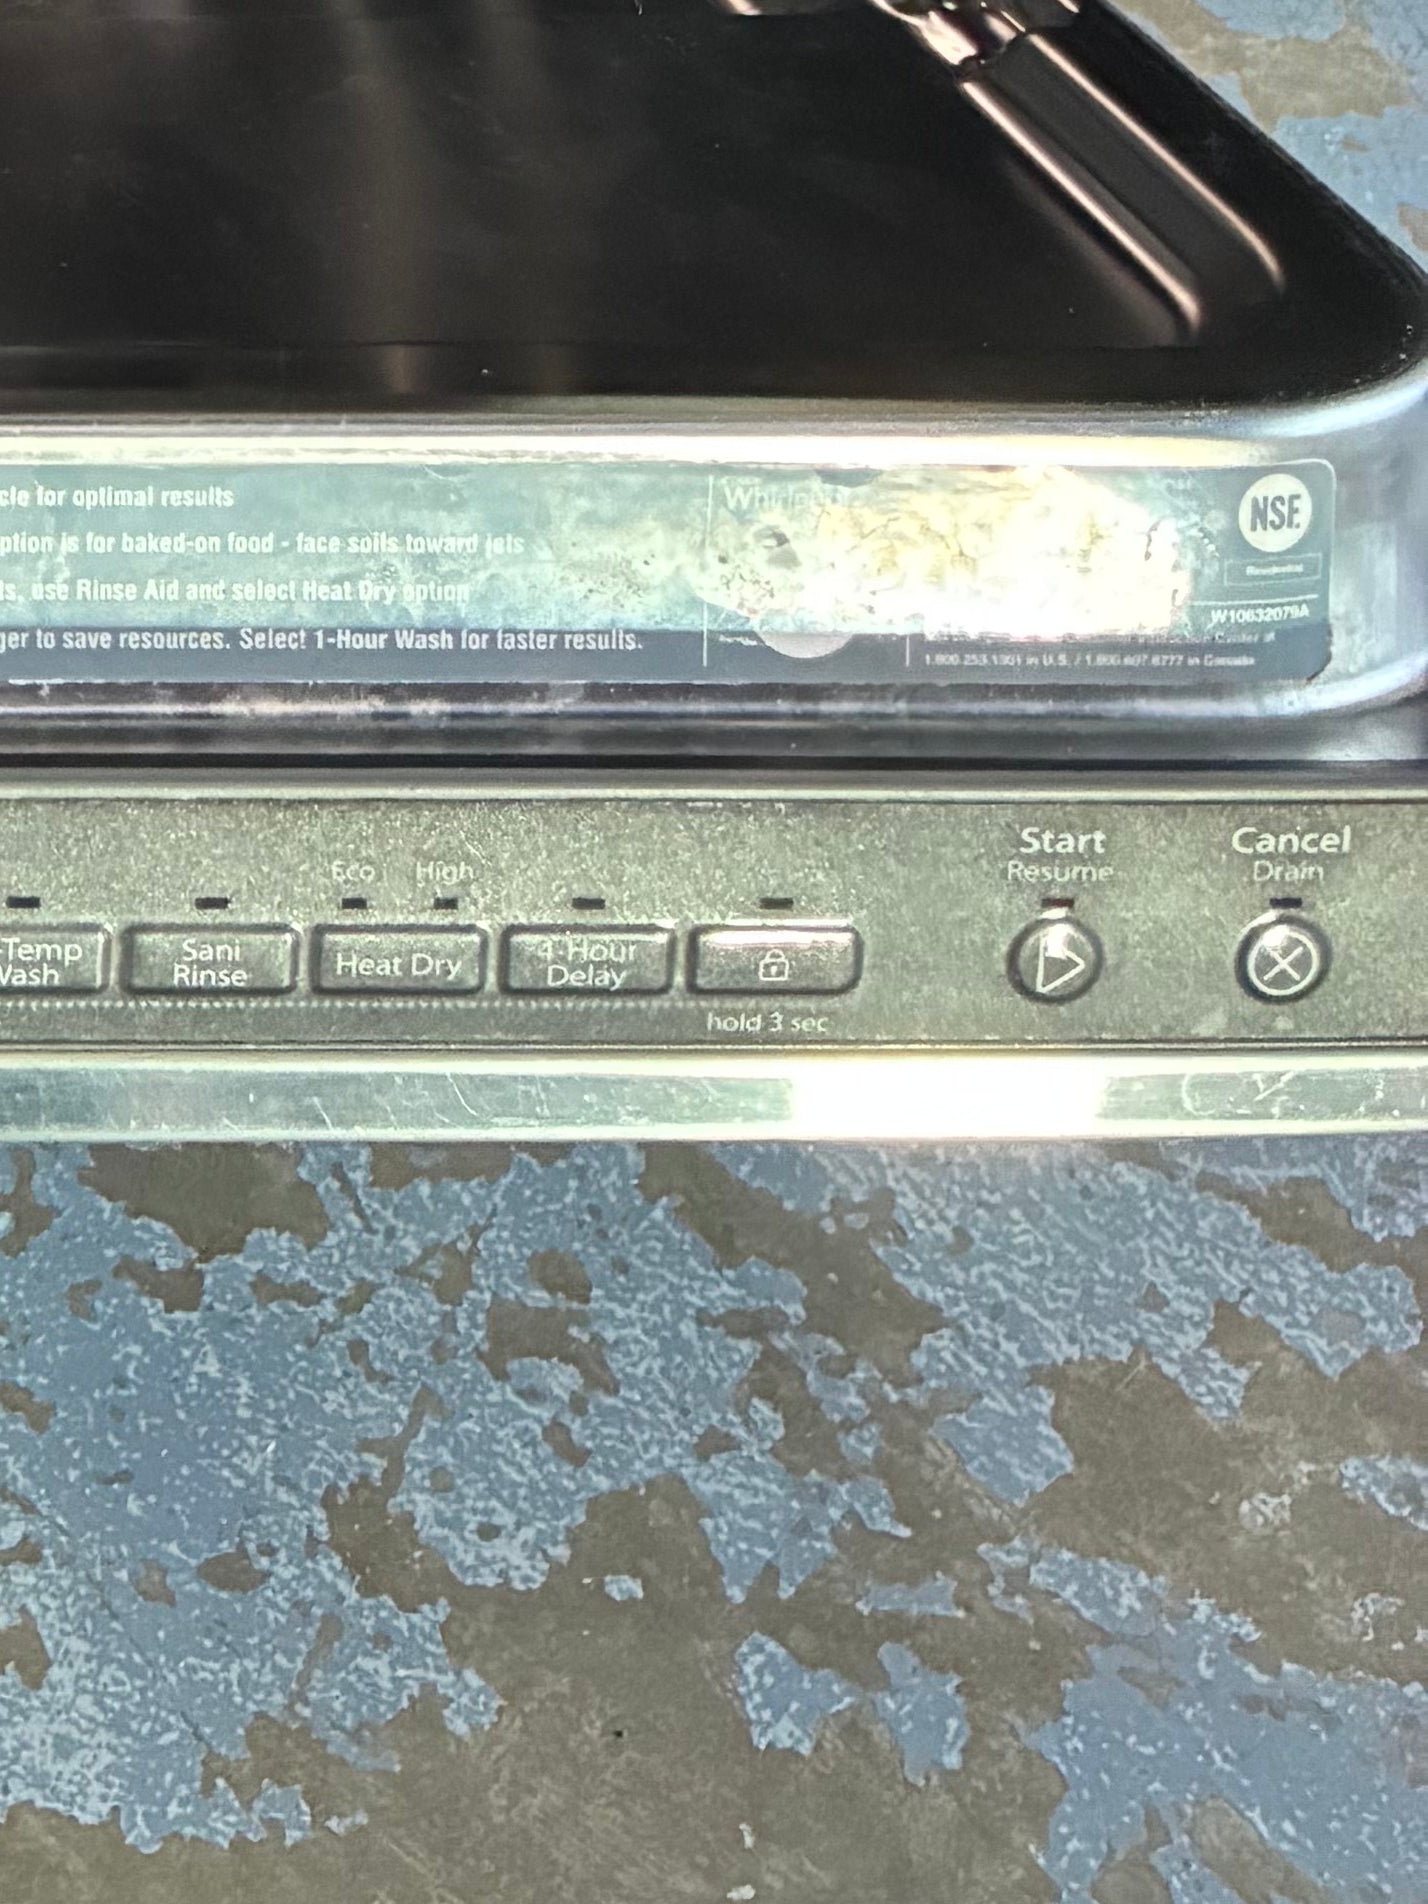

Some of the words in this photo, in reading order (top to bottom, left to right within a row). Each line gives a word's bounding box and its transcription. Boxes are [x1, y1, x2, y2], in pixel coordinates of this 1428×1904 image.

[36, 486, 64, 509] for
[72, 486, 153, 513] optimal
[161, 486, 234, 509] results
[60, 533, 79, 555] is
[86, 533, 116, 555] for
[121, 534, 221, 555] baked-on
[227, 534, 274, 555] food
[295, 534, 340, 555] face
[347, 534, 398, 555] soils
[405, 534, 478, 555] toward
[485, 534, 525, 559] jets
[30, 584, 68, 601] use
[75, 579, 136, 601] Rinse
[144, 580, 179, 602] Aid
[185, 580, 225, 602] and
[231, 580, 296, 602] select
[301, 580, 352, 602] Heat
[358, 580, 397, 606] Dry
[402, 580, 463, 606] option
[36, 628, 55, 650] to
[63, 633, 112, 650] save
[120, 633, 230, 650] resources.
[239, 629, 306, 651] Select
[314, 629, 388, 651] 1-Hour
[395, 629, 453, 651] Wash
[461, 629, 489, 651] for
[497, 629, 557, 651] faster
[564, 629, 642, 651] results.
[1019, 826, 1106, 854] Start
[1232, 824, 1351, 854] Cancel
[331, 860, 375, 881] Eco
[415, 861, 474, 886] High
[1007, 859, 1114, 883] Resume
[1252, 859, 1325, 882] Drain
[181, 938, 241, 962] Sani
[173, 964, 248, 987] Rinse
[335, 952, 402, 977] Heat
[411, 953, 463, 980] Dry
[546, 965, 627, 992] Delay
[706, 1011, 763, 1032] hold
[769, 1011, 784, 1032] 3
[791, 1016, 829, 1033] sec
